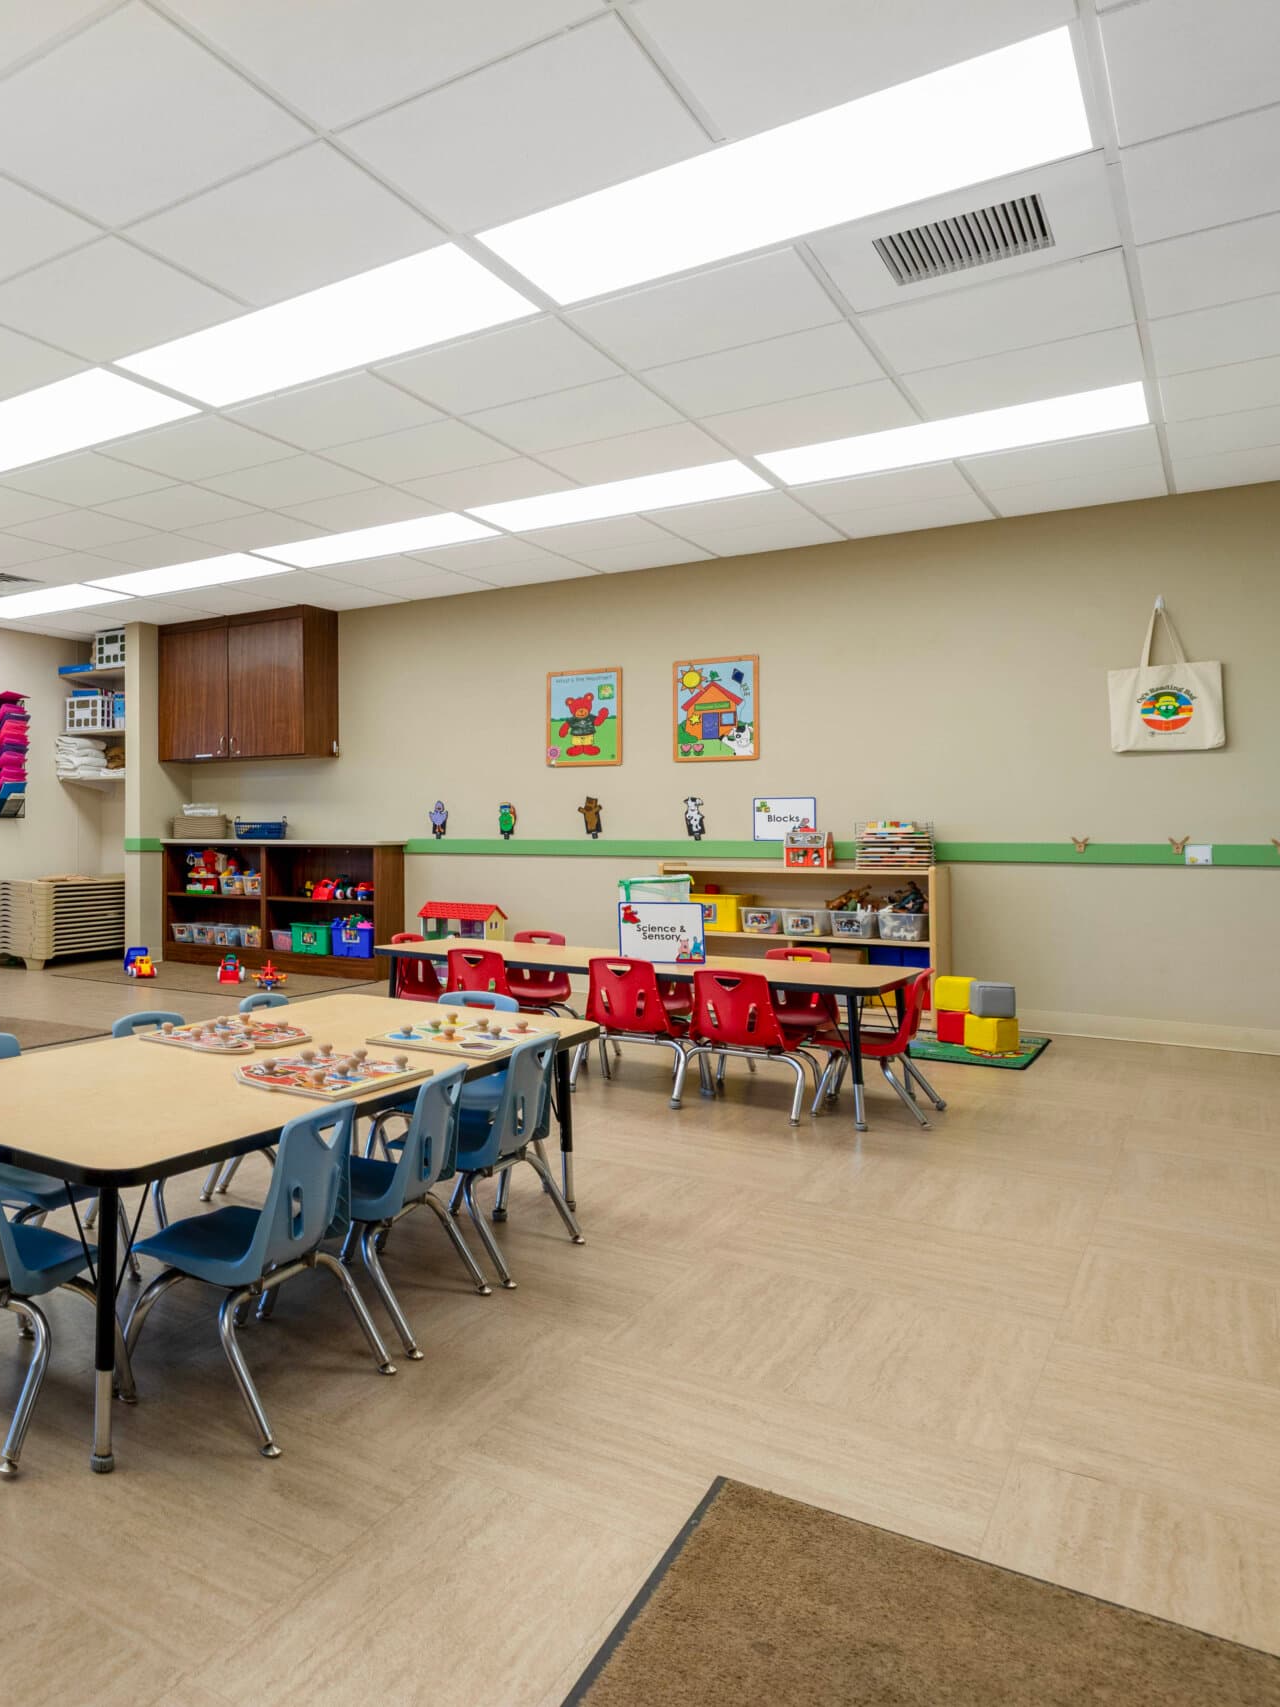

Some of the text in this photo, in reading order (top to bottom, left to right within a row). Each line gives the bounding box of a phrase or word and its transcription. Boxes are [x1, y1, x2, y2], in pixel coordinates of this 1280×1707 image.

[767, 814, 800, 823] Blocks
[636, 924, 687, 933] Science &
[641, 932, 681, 942] Sensory
